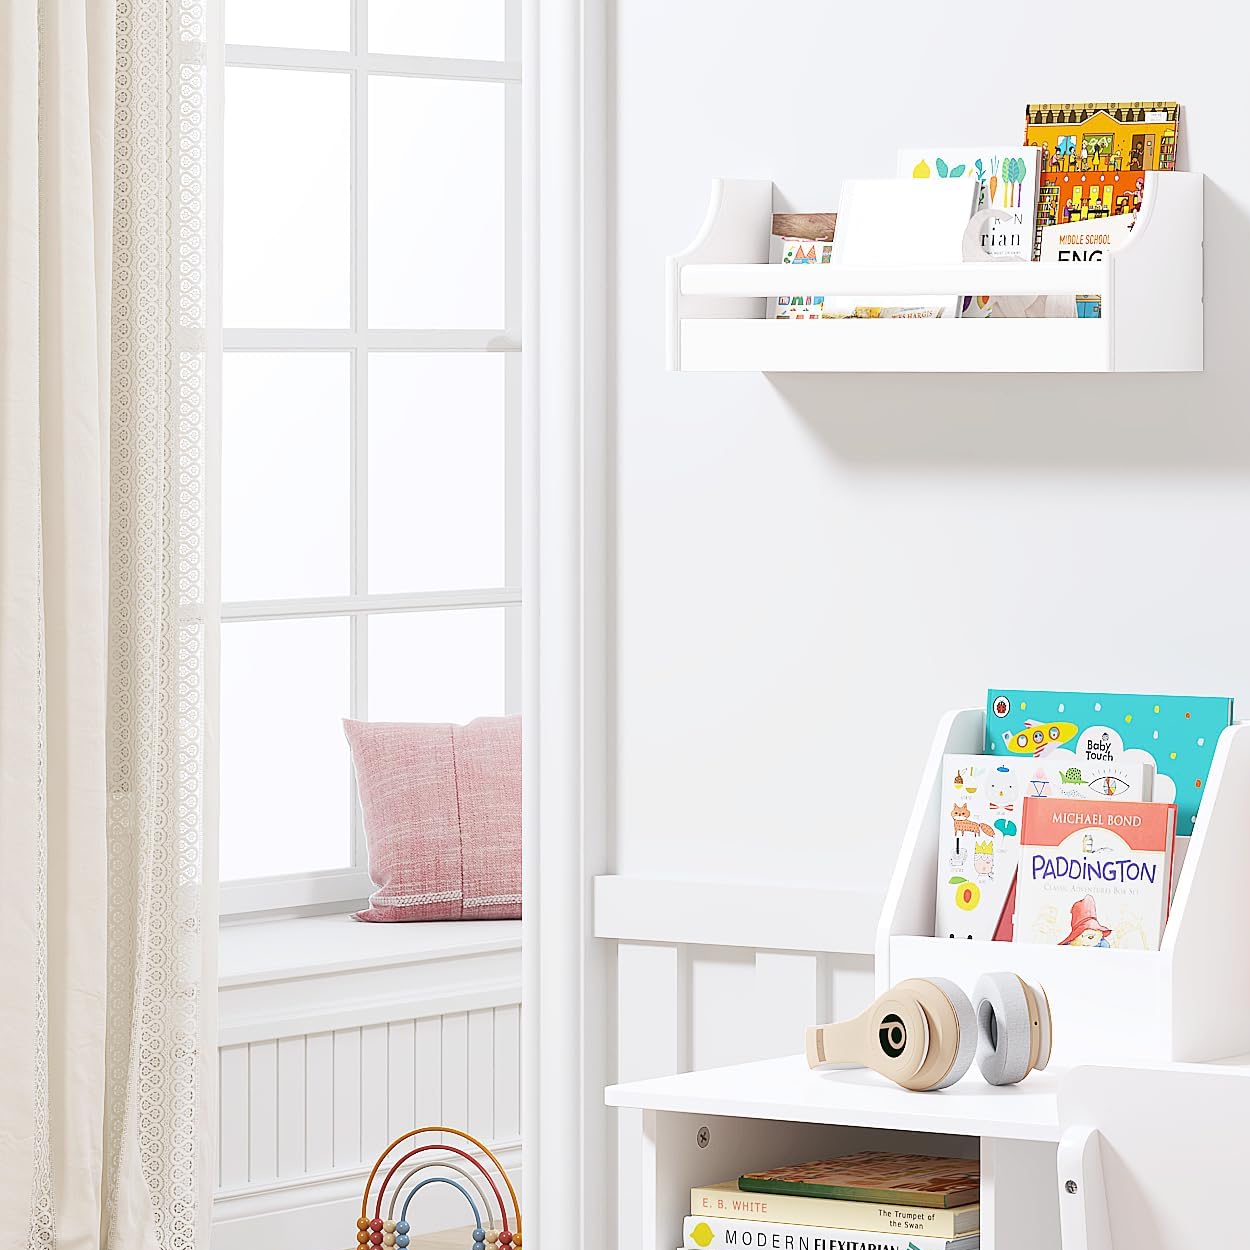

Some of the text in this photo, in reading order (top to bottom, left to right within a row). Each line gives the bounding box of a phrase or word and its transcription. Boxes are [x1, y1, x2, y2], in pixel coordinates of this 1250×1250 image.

[1059, 234, 1110, 244] MIDDLE SCHOOL
[1087, 740, 1112, 754] Baby
[1086, 750, 1114, 762] Touch
[1052, 812, 1142, 826] MICHAEL BOND
[702, 1198, 768, 1213] E. B. WHITE
[878, 1209, 892, 1218] The
[894, 1210, 924, 1220] Trumpet
[890, 1220, 924, 1230] the Swan
